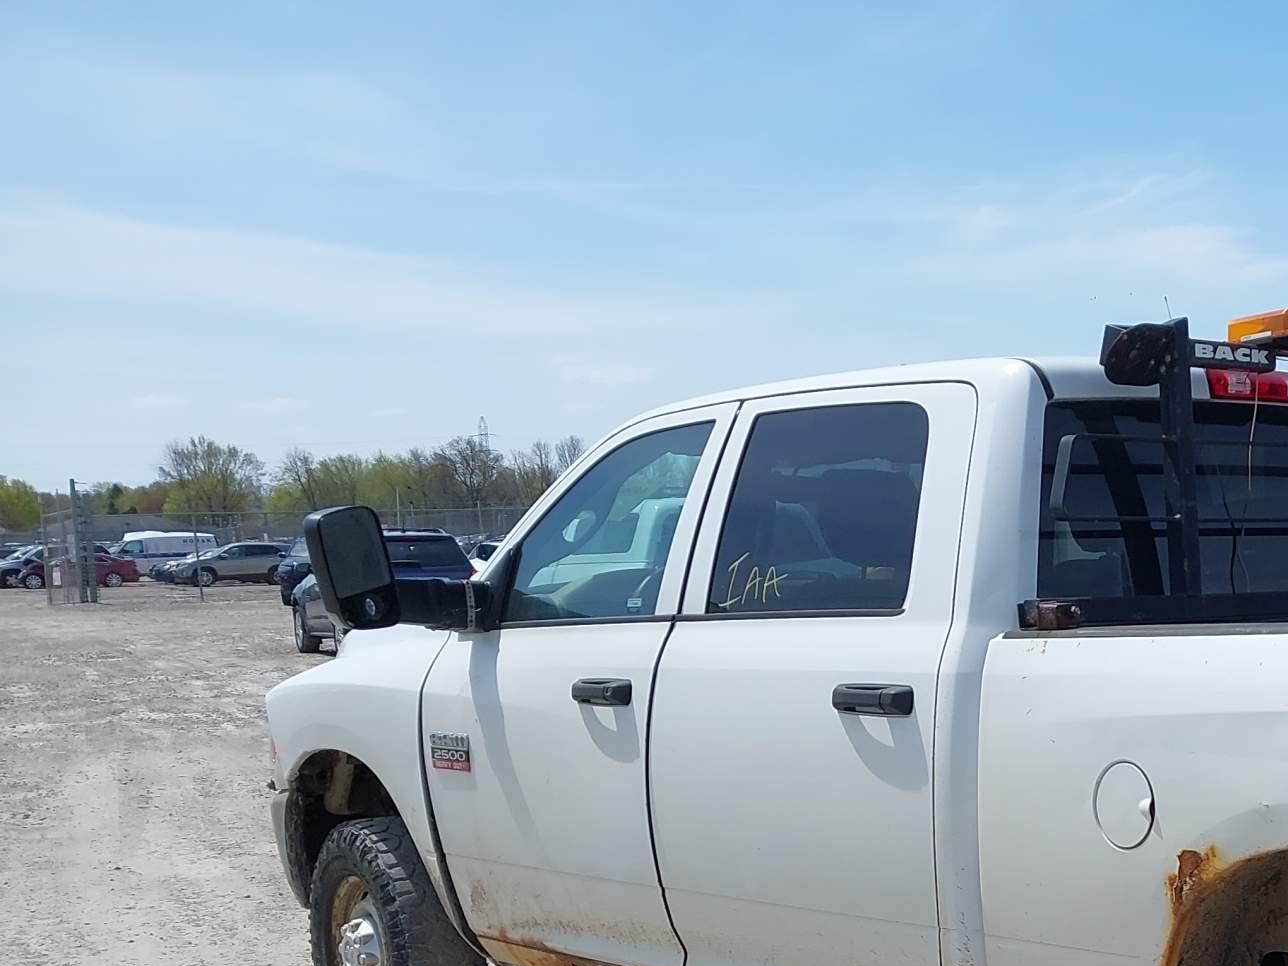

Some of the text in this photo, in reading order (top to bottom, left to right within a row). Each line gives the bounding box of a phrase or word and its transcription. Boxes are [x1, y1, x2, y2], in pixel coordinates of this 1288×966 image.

[1194, 342, 1270, 365] BACK
[718, 551, 789, 609] IAA
[433, 749, 466, 761] 2500
